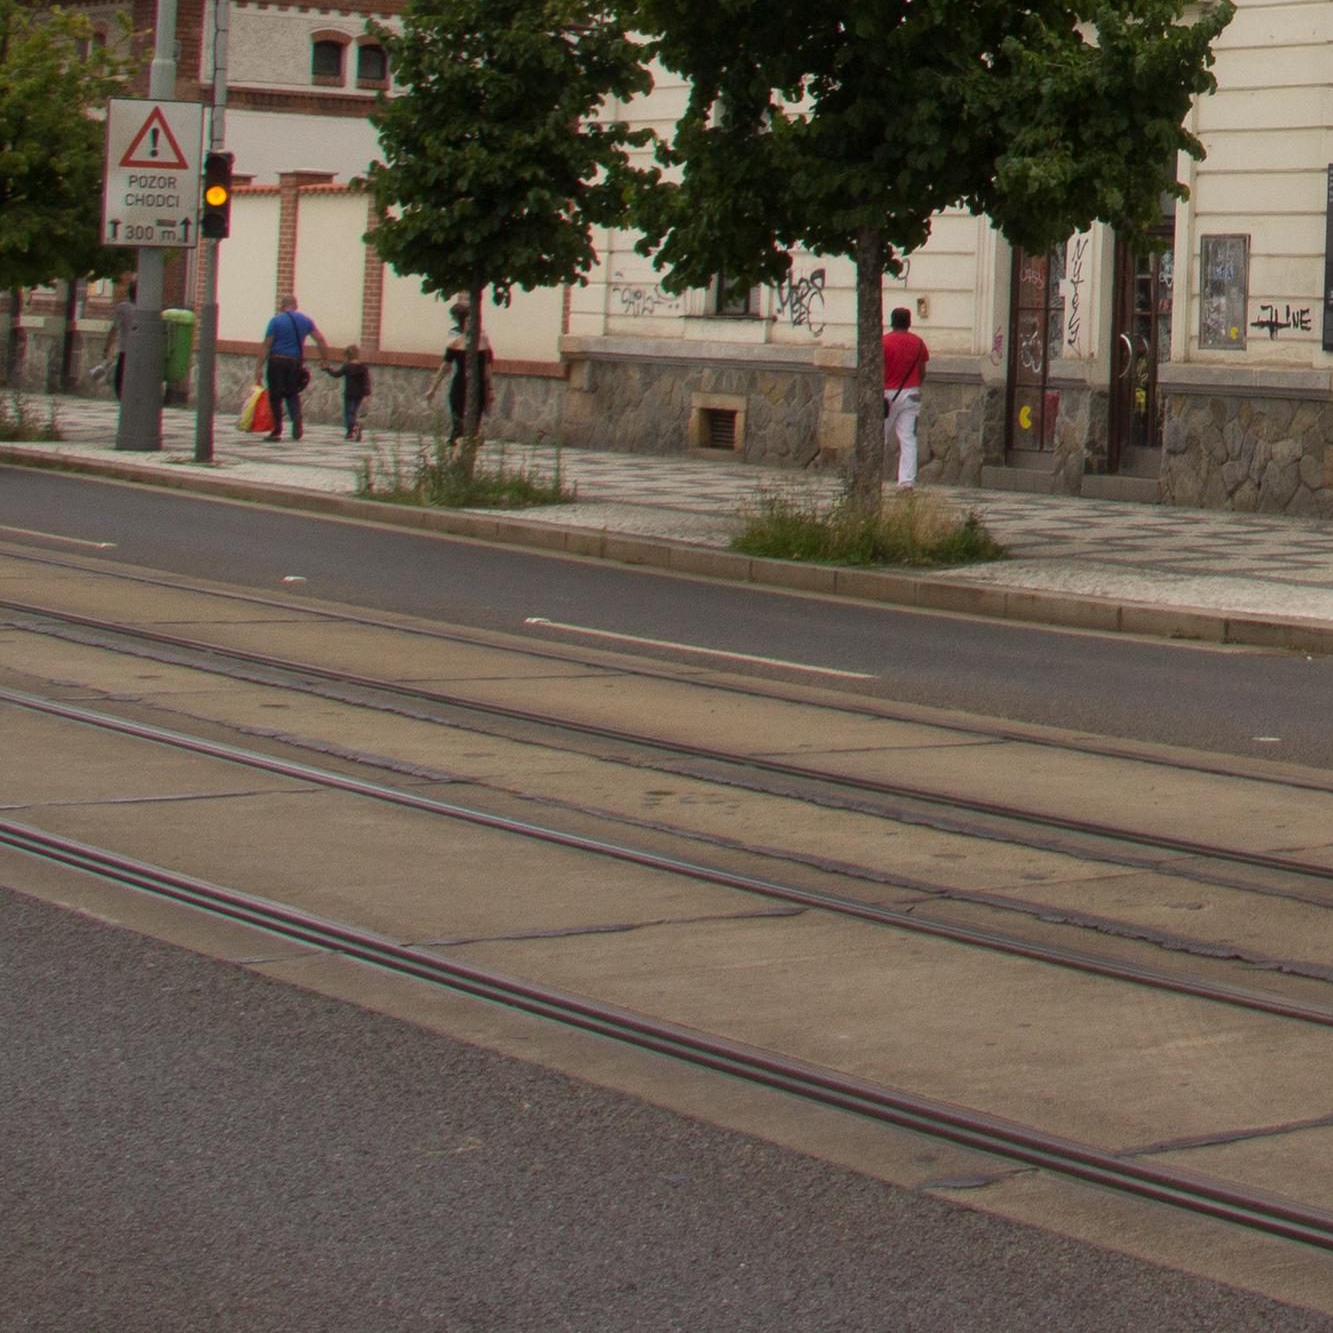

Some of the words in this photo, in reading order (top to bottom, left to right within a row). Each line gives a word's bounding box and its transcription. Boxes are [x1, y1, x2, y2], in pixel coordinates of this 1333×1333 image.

[128, 175, 177, 189] POZOR
[125, 193, 179, 207] CHODCI
[125, 225, 154, 240] 300
